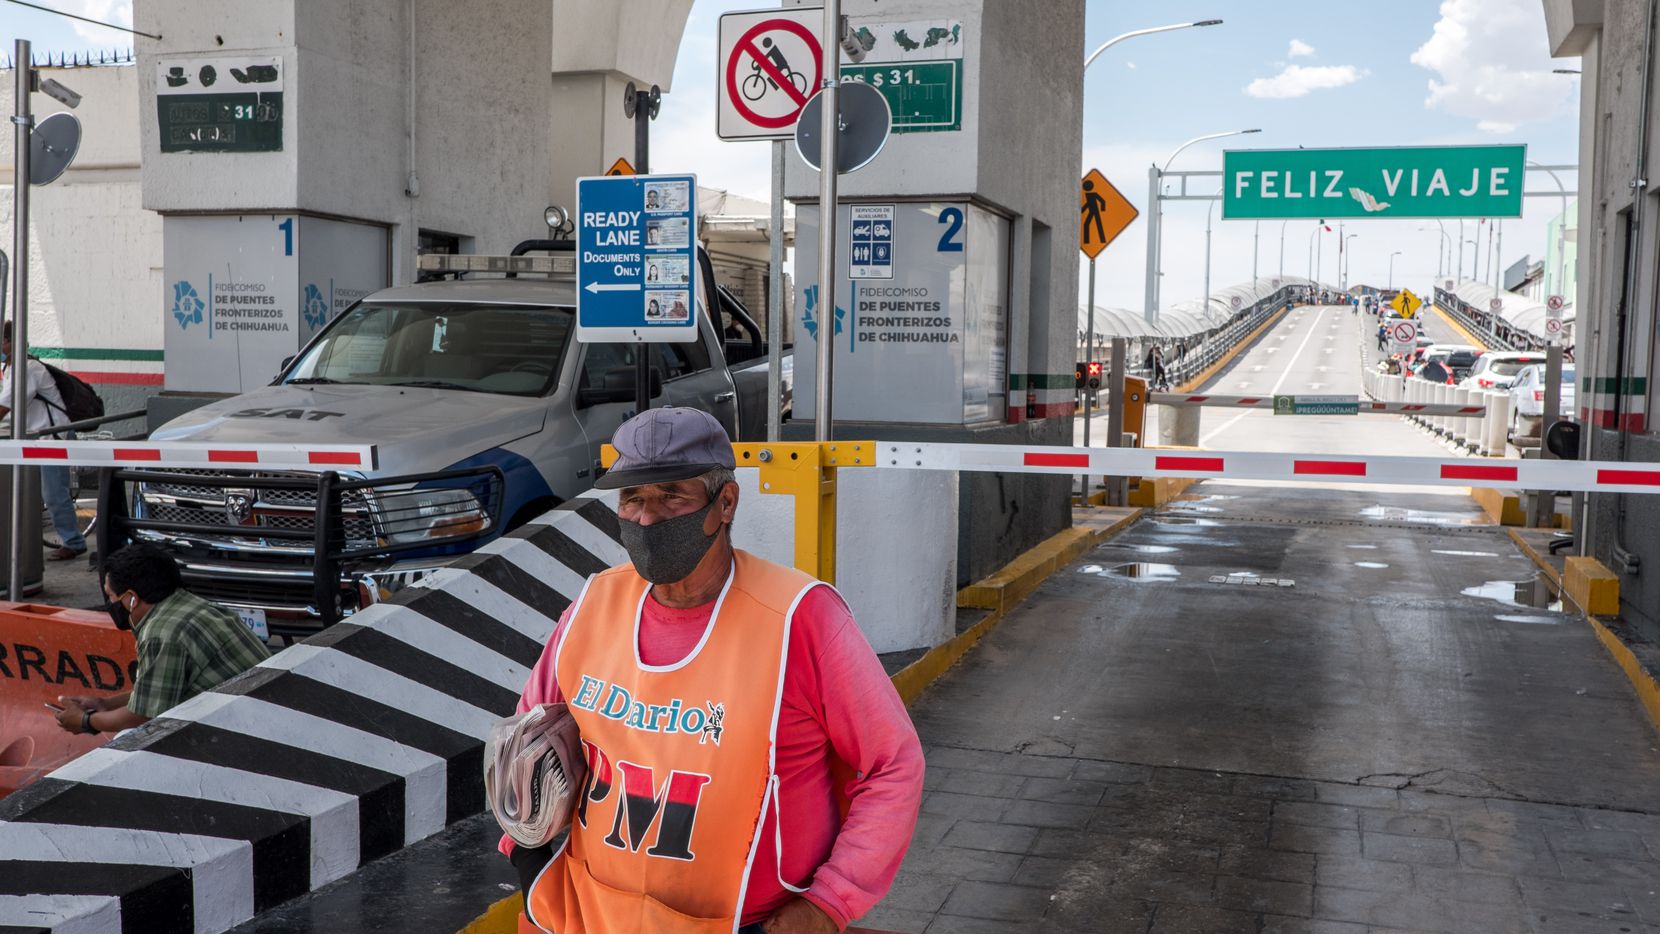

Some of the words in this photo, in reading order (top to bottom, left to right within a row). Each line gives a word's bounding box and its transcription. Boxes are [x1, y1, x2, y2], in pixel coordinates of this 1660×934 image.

[235, 105, 253, 119] 31
[1235, 170, 1344, 198] FELIZ
[1382, 167, 1509, 197] VIAJE
[584, 211, 641, 228] READY
[937, 207, 964, 252] 2
[279, 217, 293, 256] 1
[596, 230, 640, 246] LANE
[584, 251, 641, 263] DOCUMENTS
[614, 264, 641, 276] ONLY
[215, 283, 266, 292] FIDEICOMISO
[859, 287, 928, 297] FIDEICOMISO
[215, 295, 228, 304] DE
[230, 296, 275, 305] PUENTES
[859, 302, 877, 311] DE
[880, 302, 941, 312] PUENTES
[215, 309, 283, 318] FRONTERIZOS
[215, 322, 228, 330] DE
[230, 322, 289, 332] CHIHUAHUA
[859, 317, 951, 327] FRONTERIZOS
[859, 332, 877, 342] DE
[879, 332, 959, 343] CHIHUAHUA
[230, 408, 346, 421] SAT
[573, 676, 603, 711] El
[578, 738, 711, 861] PM
